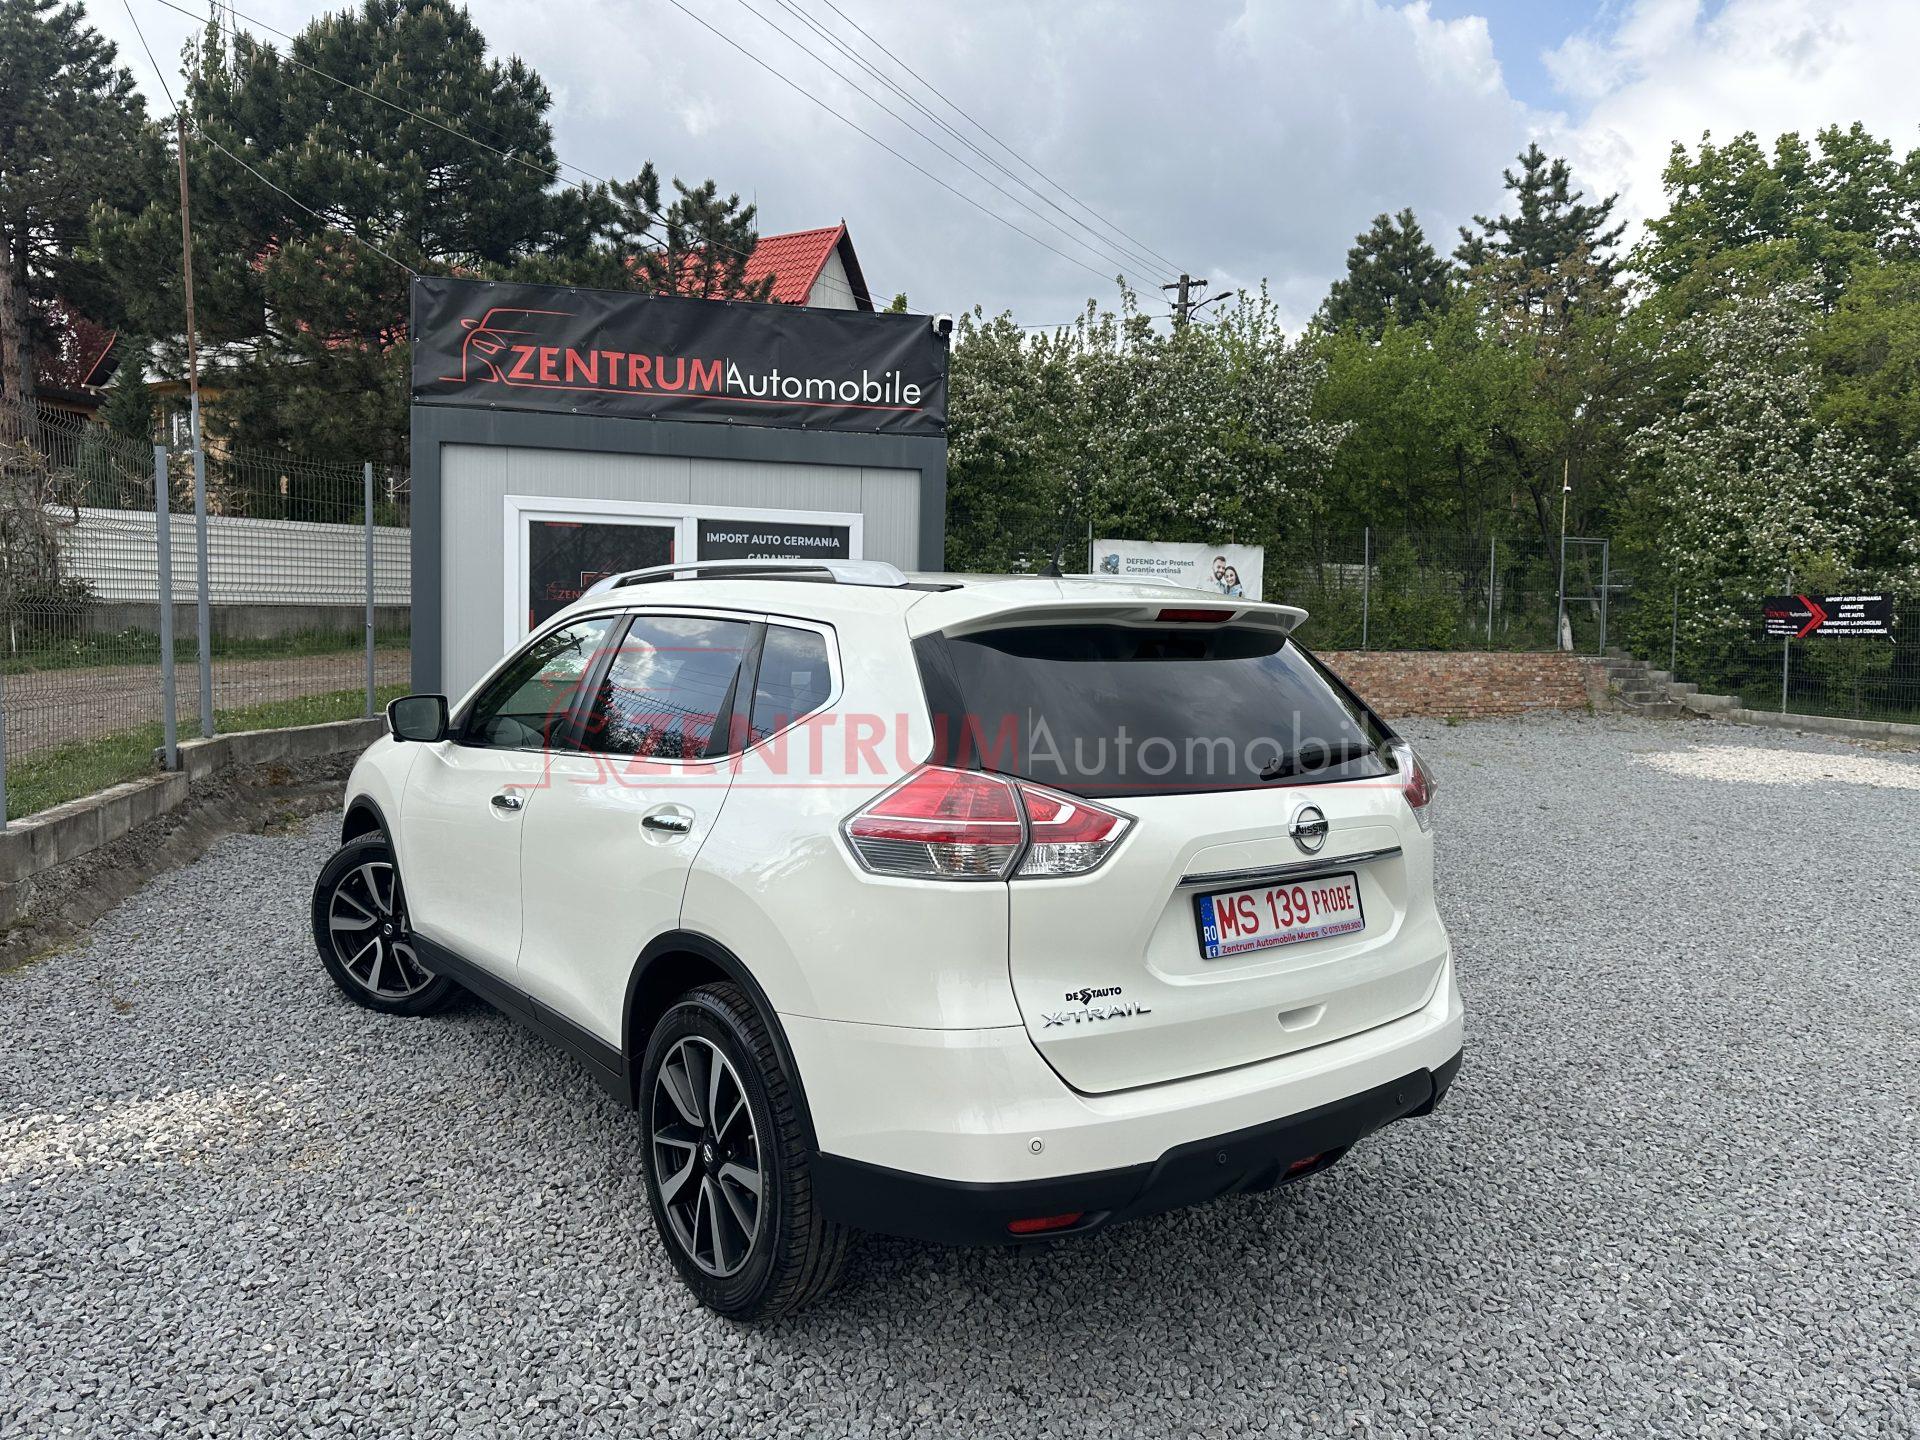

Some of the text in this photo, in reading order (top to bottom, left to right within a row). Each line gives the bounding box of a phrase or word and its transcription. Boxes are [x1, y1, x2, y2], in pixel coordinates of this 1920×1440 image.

[507, 344, 922, 406] ZENTRUM Automobile
[706, 532, 840, 547] IMPORT AUTO GERMANIA
[1126, 557, 1194, 567] DEFEND Car Protect
[1295, 822, 1329, 835] NISSAN
[1216, 885, 1354, 939] MS 139 PROBE
[1203, 926, 1217, 942] RO
[1221, 942, 1255, 954] Zentrum
[1255, 934, 1296, 948] Automobile
[1041, 1001, 1152, 1029] X-TRAIL
